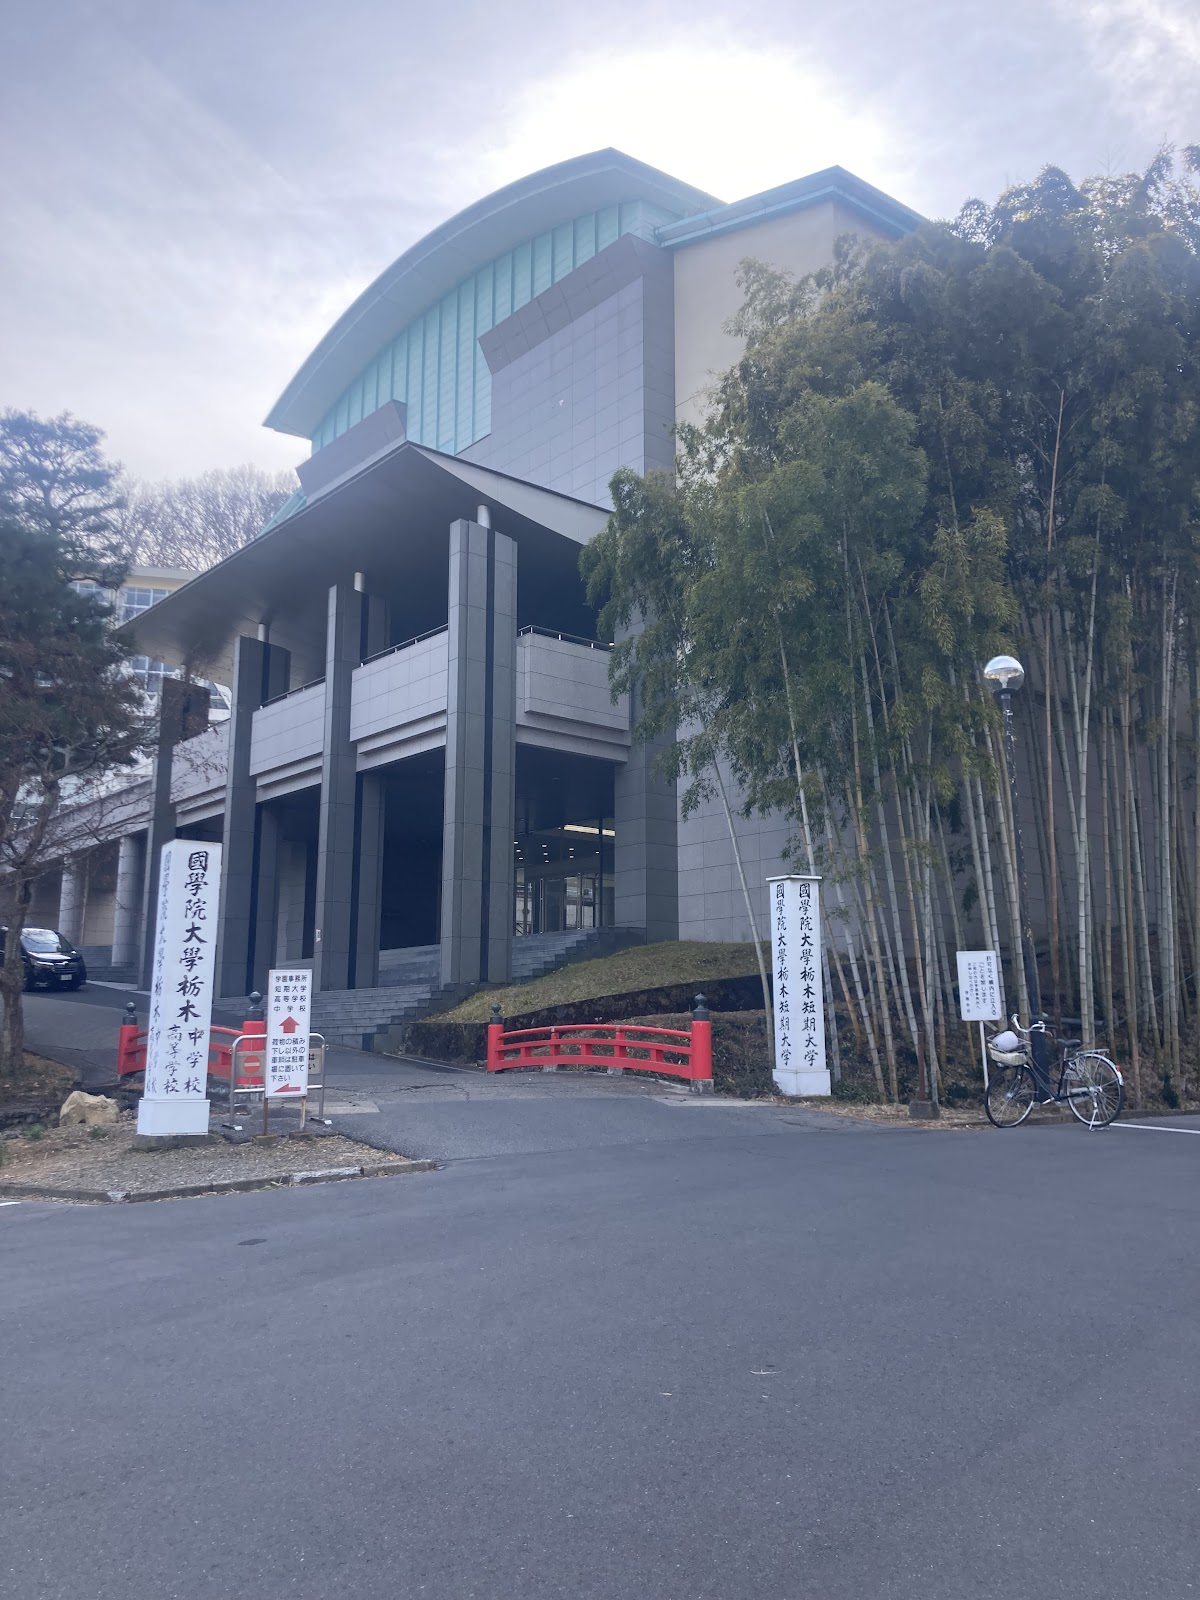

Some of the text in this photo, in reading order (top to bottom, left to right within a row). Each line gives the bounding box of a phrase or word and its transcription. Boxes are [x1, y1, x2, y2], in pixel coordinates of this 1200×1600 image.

[176, 850, 209, 1023] 國學院大學栃木
[275, 975, 308, 983] 学園事務所
[776, 883, 792, 1067] 國學院大學栃木短期大学
[799, 883, 818, 1067] 國學院大學栃木短期大学
[274, 985, 307, 993] 短期大学
[274, 995, 307, 1003] 高等学校
[274, 1005, 306, 1013] 中学校
[272, 1038, 306, 1046] 荷物の積み
[272, 1047, 306, 1055] 下し以外の
[163, 1024, 182, 1095] 高等学校
[184, 1027, 205, 1095] 中学校
[271, 1064, 305, 1073] 場に置いて
